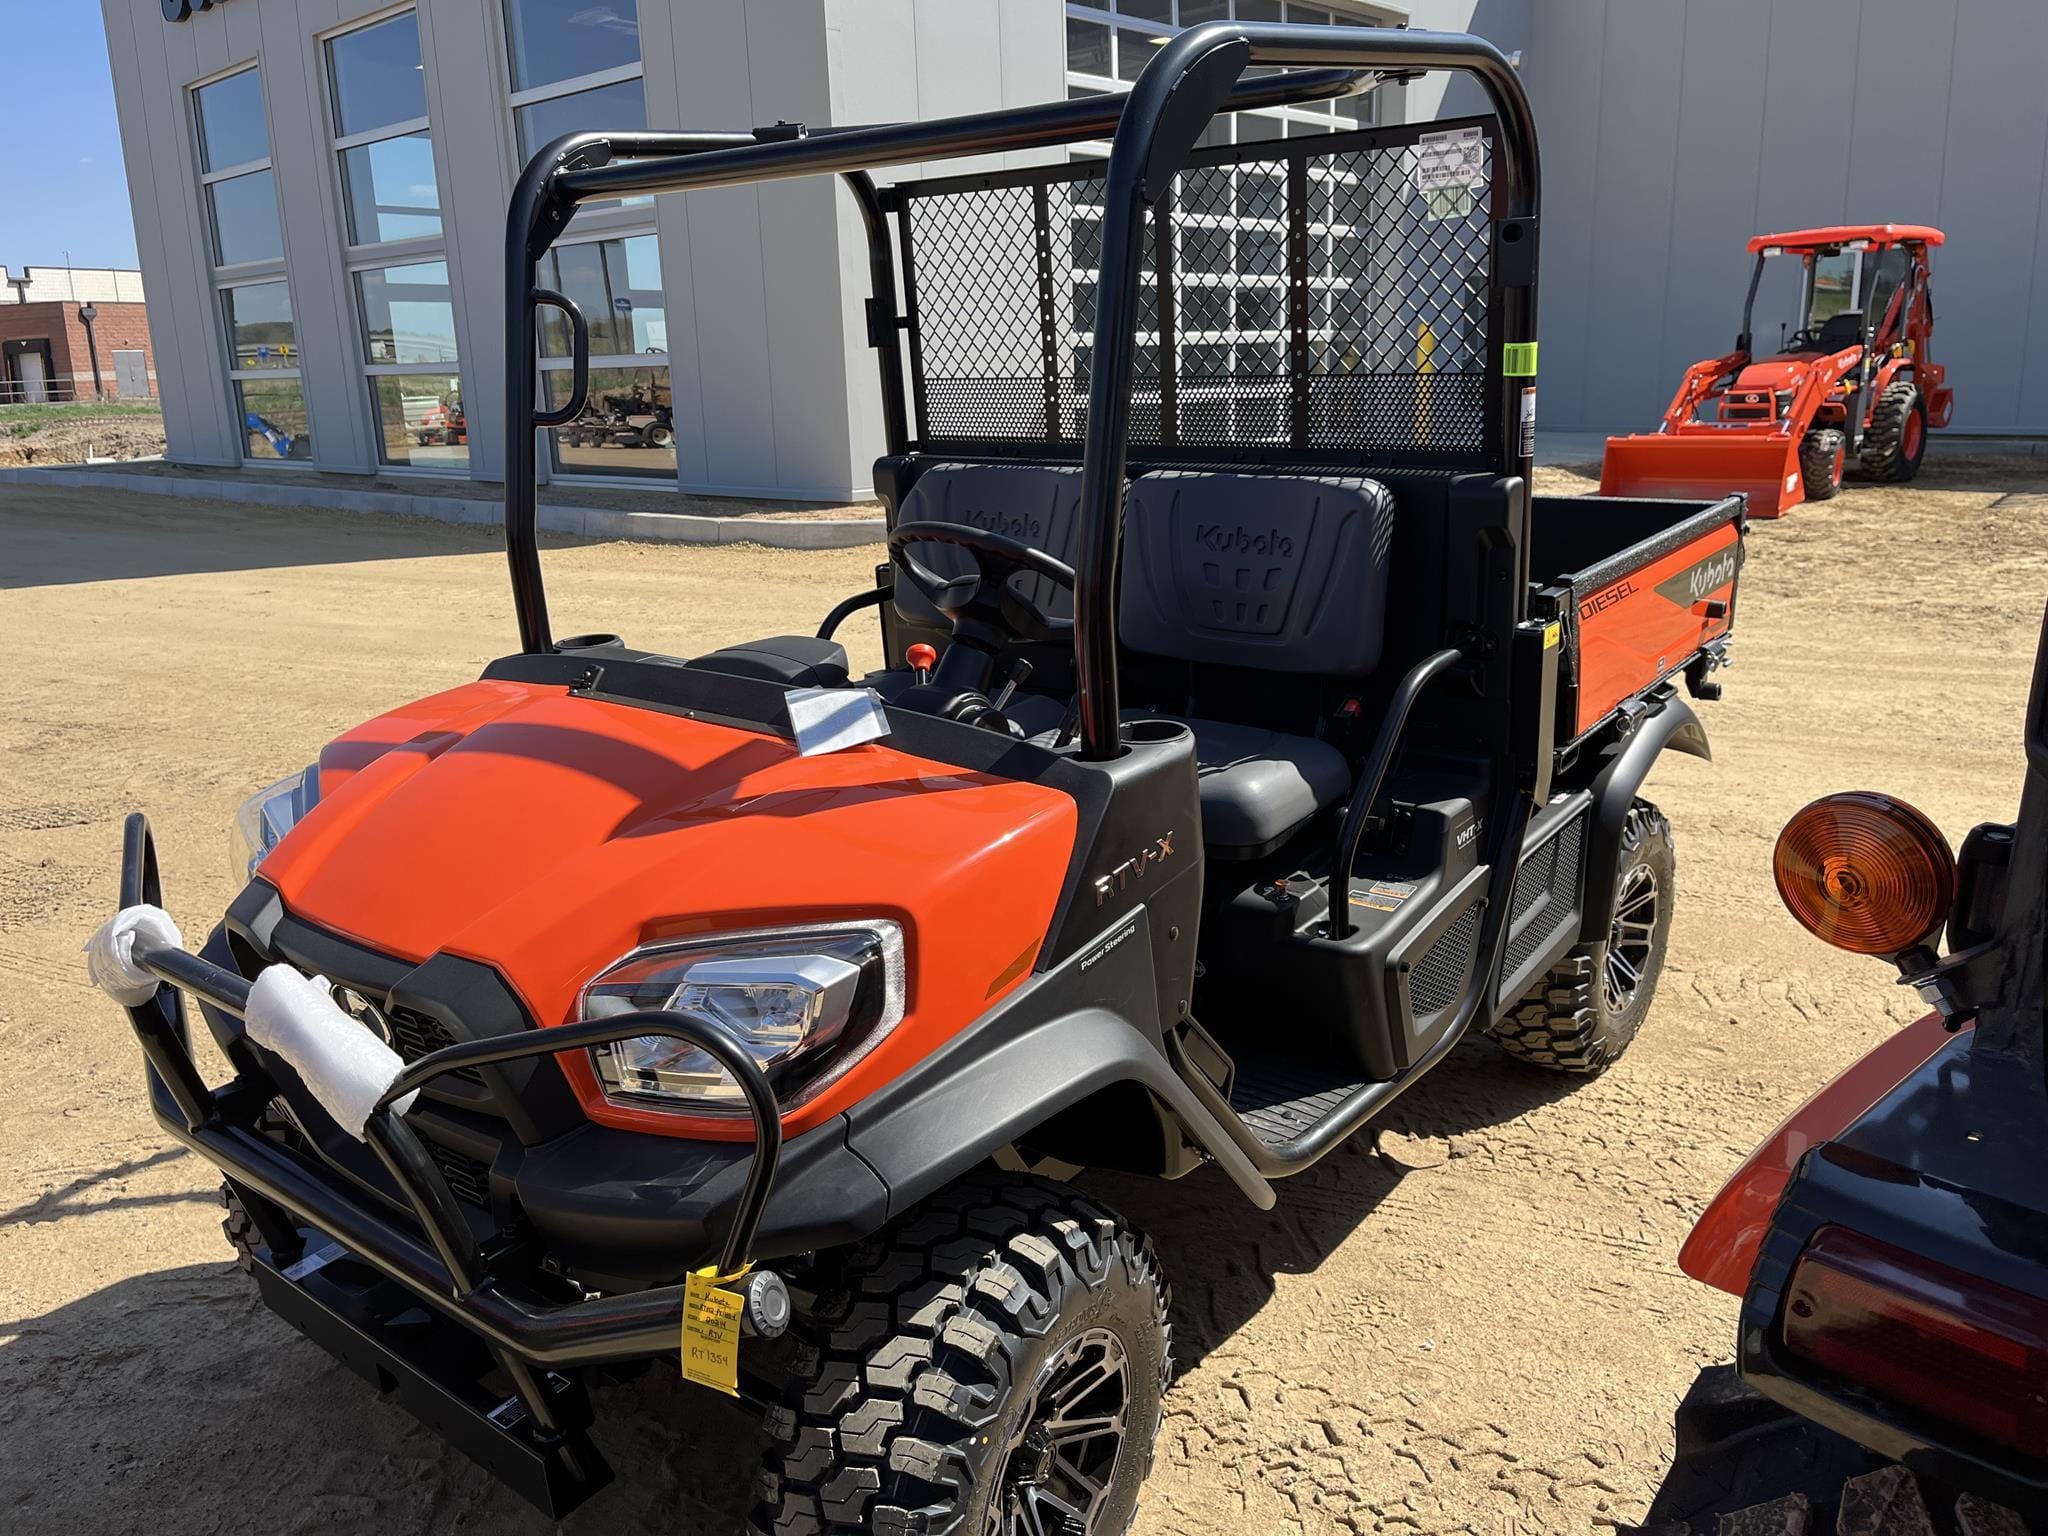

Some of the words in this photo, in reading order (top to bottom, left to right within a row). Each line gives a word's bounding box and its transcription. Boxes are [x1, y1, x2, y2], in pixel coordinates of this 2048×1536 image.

[1194, 524, 1294, 558] Kubota
[1689, 553, 1735, 597] Kubota
[1579, 581, 1640, 621] DIESEL
[1094, 830, 1176, 907] RTV-X
[1080, 948, 1105, 972] Power
[1105, 925, 1136, 953] Steering
